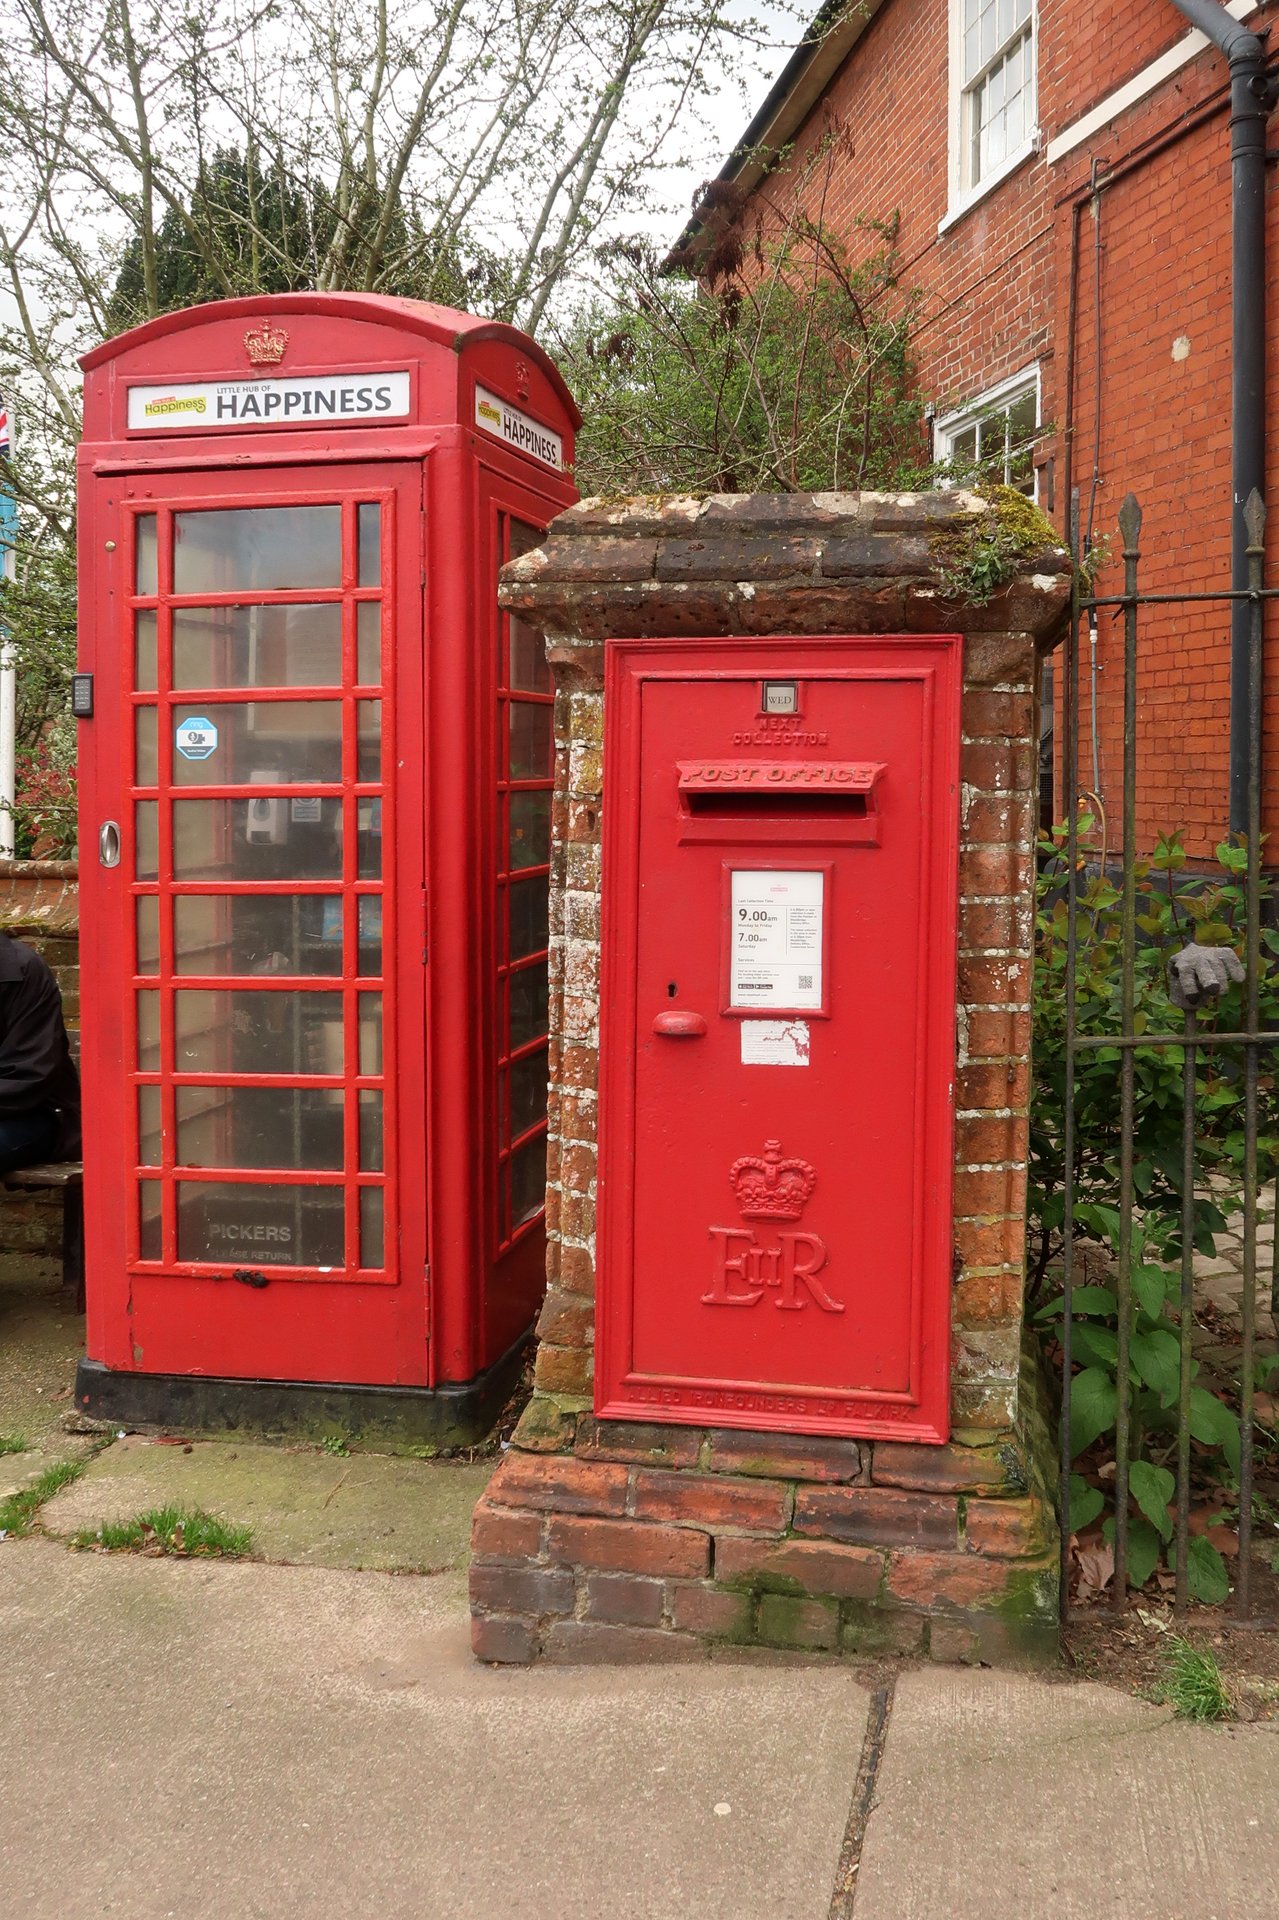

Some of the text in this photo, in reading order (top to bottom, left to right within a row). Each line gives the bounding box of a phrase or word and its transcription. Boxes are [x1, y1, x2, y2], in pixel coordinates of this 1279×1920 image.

[144, 399, 206, 414] Happiness
[216, 386, 392, 419] HAPPINESS
[503, 414, 557, 465] HAPPINESS
[768, 696, 792, 705] WED
[760, 718, 801, 731] NEXT
[733, 731, 828, 746] COLLECTION
[683, 767, 873, 784] POST OFFICE
